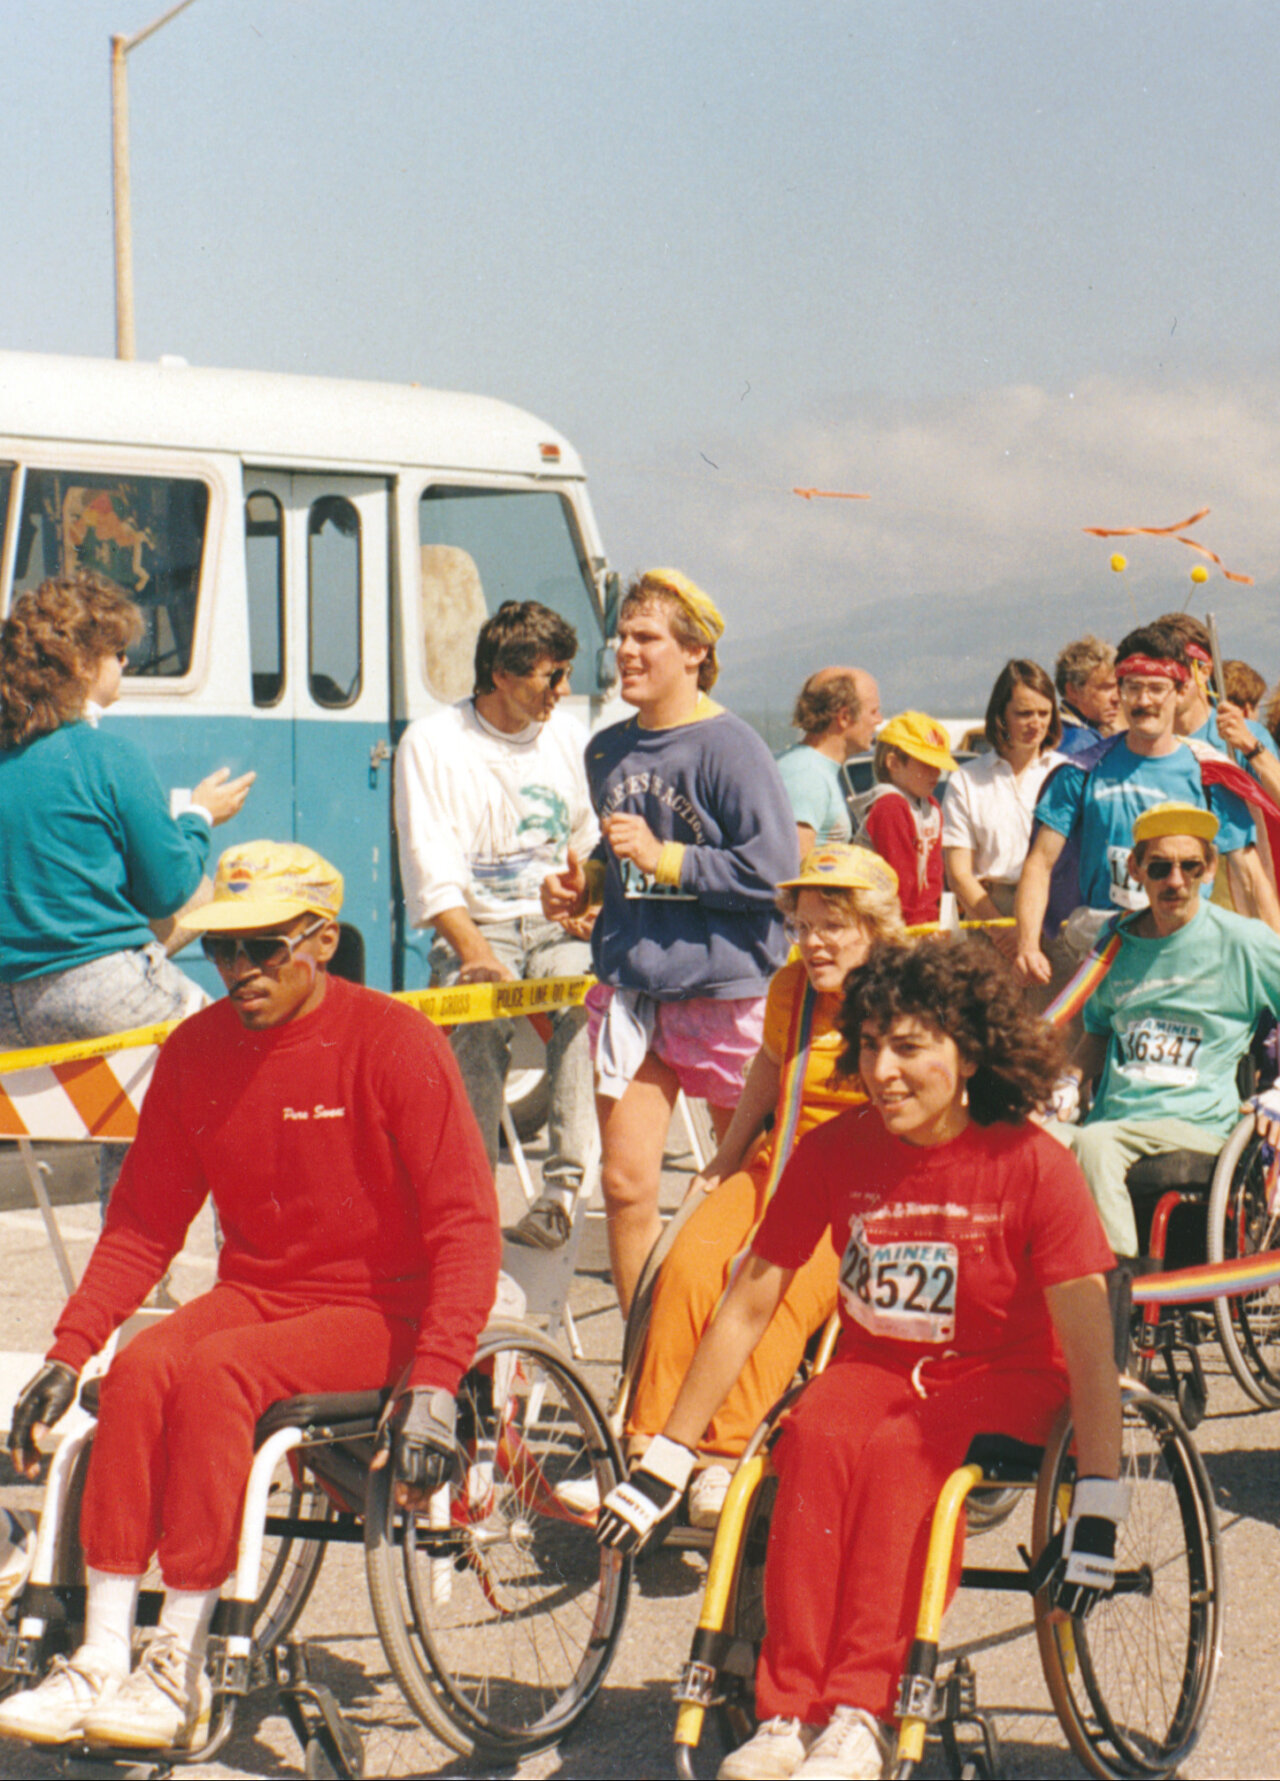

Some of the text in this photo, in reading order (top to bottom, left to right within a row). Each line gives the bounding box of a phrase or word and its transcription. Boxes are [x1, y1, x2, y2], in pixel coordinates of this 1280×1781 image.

[440, 993, 472, 1017] CROSS
[496, 987, 525, 1010] POLICE
[530, 984, 549, 1006] LINE
[1138, 1019, 1200, 1037] AMINER
[870, 1246, 948, 1262] MINER
[842, 1245, 955, 1315] 28522
